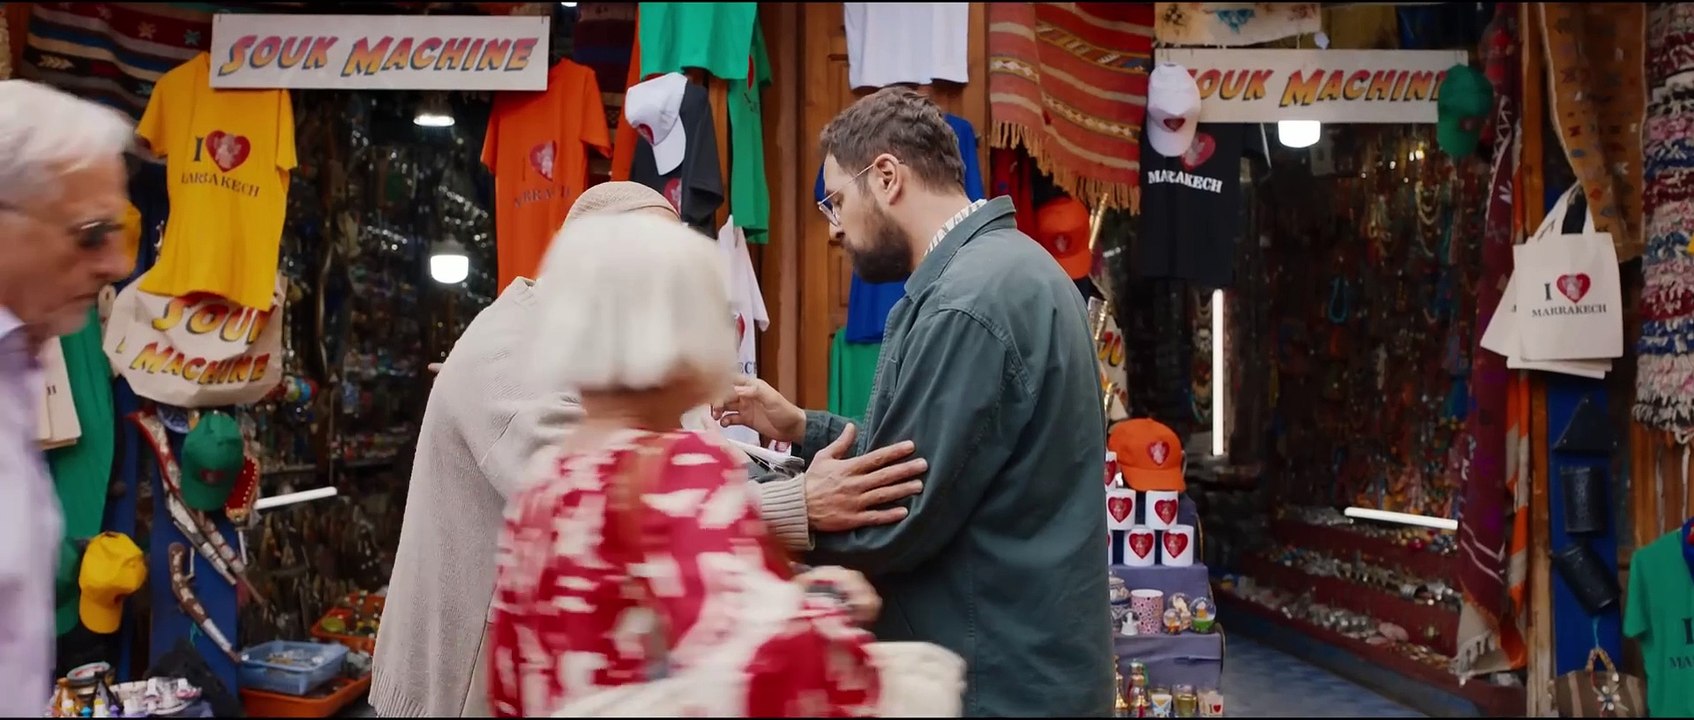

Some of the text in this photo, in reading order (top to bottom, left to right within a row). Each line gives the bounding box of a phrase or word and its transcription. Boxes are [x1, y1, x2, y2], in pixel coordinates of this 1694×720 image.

[217, 34, 540, 77] SOUK MACHINE
[1187, 68, 1275, 101] OUK
[193, 135, 204, 162] I
[1544, 282, 1552, 301] I
[1531, 303, 1607, 318] MARRAKECH
[129, 341, 271, 386] MACHINE
